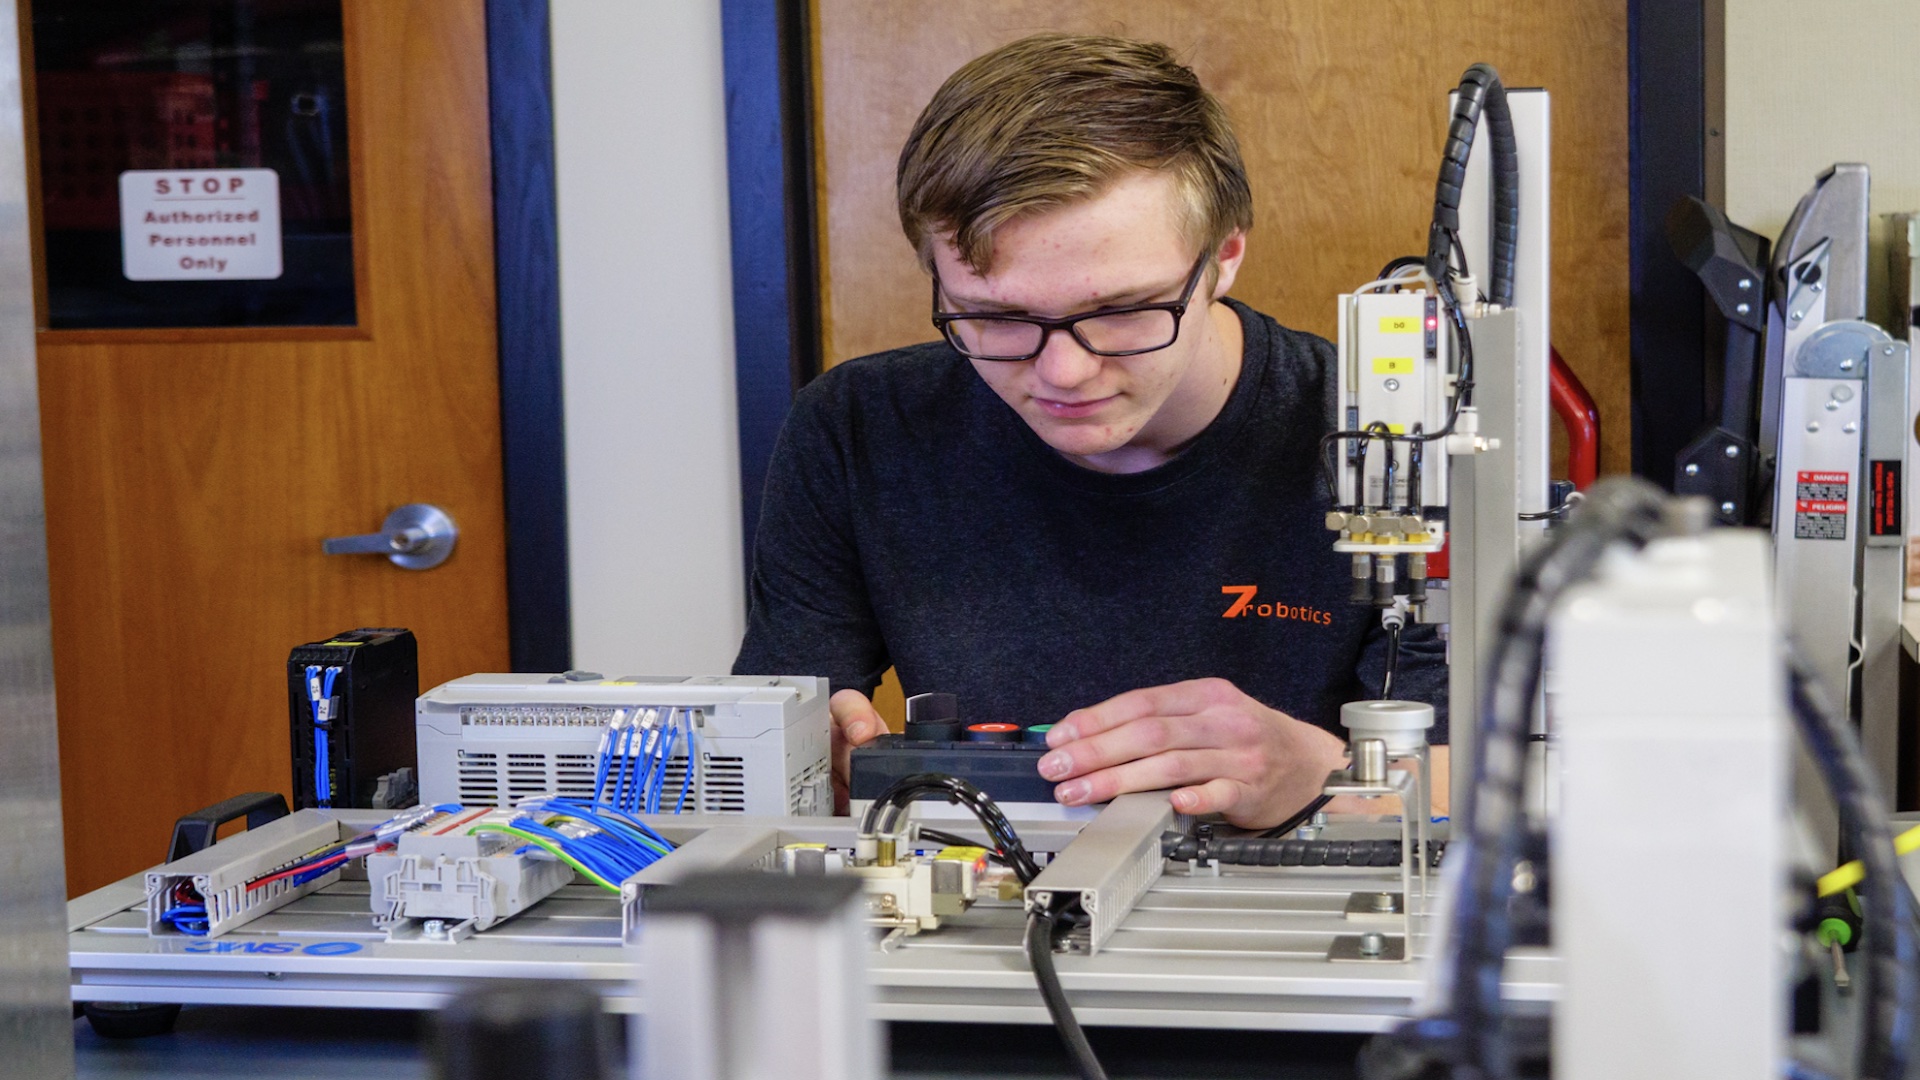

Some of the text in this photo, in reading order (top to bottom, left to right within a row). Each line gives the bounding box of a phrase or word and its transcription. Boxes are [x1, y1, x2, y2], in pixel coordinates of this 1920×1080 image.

[154, 177, 245, 195] STOP
[144, 210, 260, 224] Authorized
[148, 233, 257, 247] Personnel
[179, 256, 228, 272] Only
[1811, 503, 1846, 511] PELIGRO
